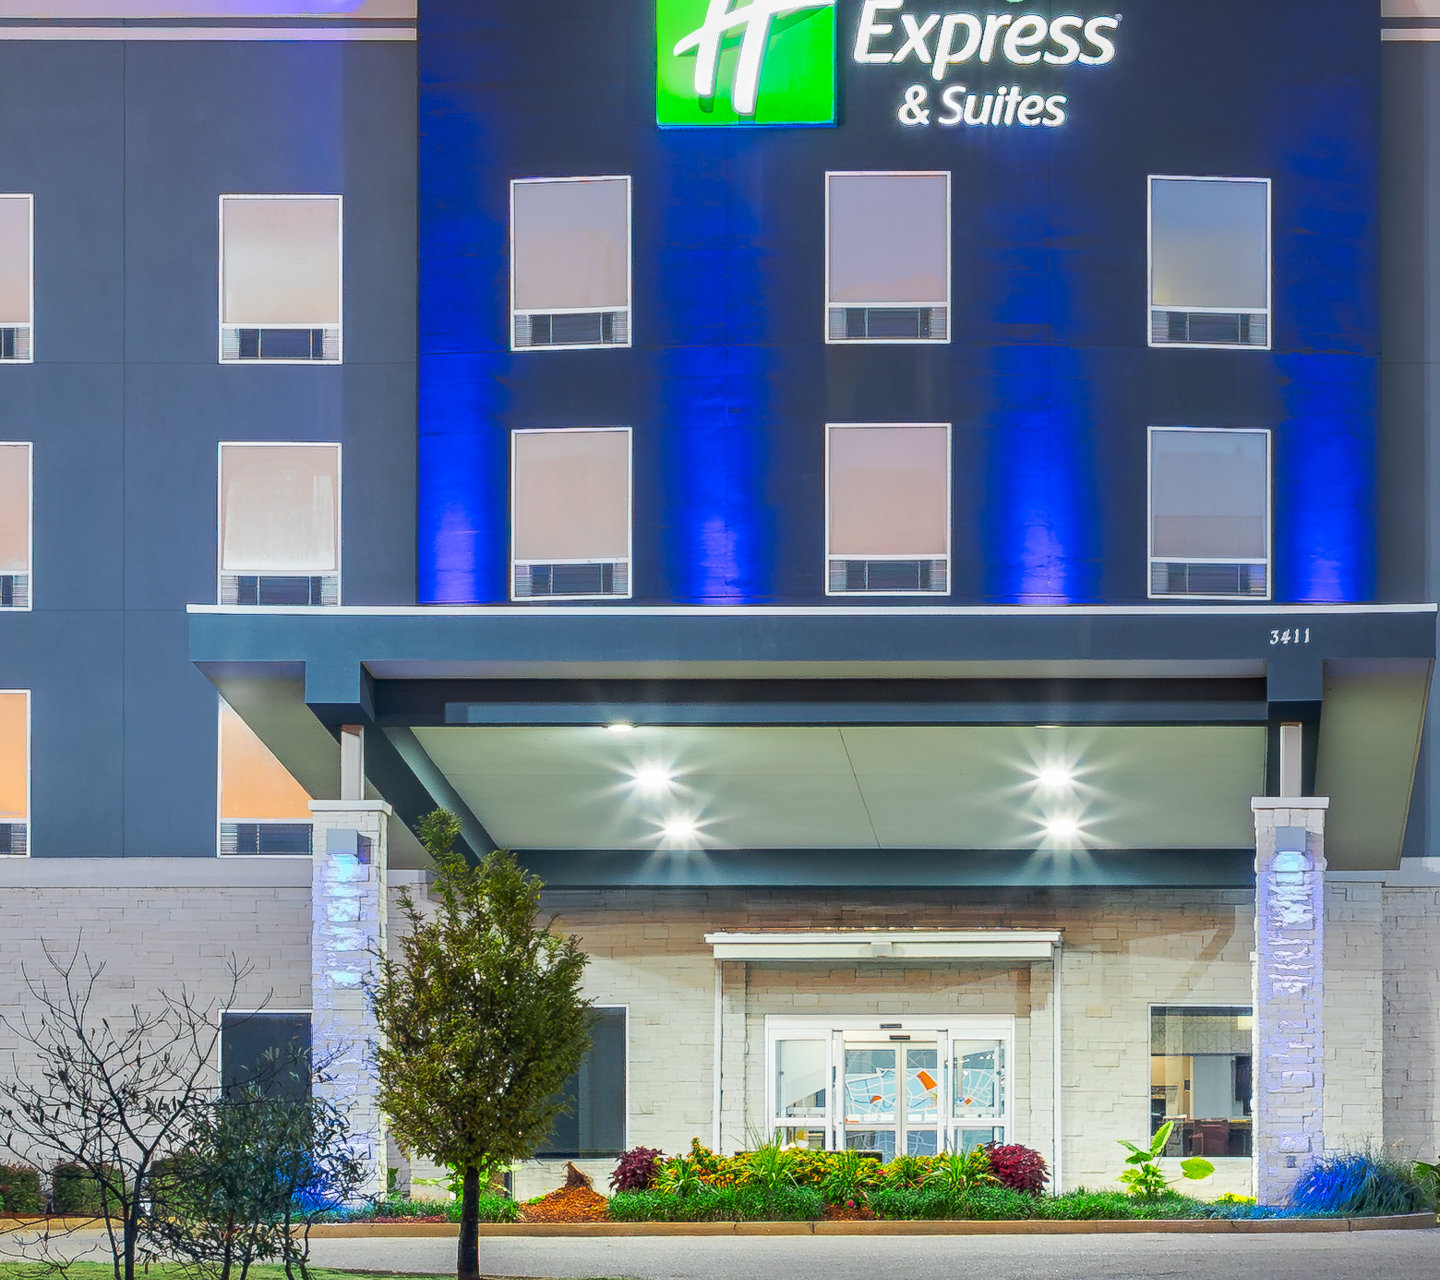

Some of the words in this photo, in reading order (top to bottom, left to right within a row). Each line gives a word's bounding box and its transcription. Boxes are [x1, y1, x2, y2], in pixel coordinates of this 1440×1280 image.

[897, 83, 931, 126] &
[937, 84, 1068, 127] Suites
[1269, 627, 1310, 645] 3411
